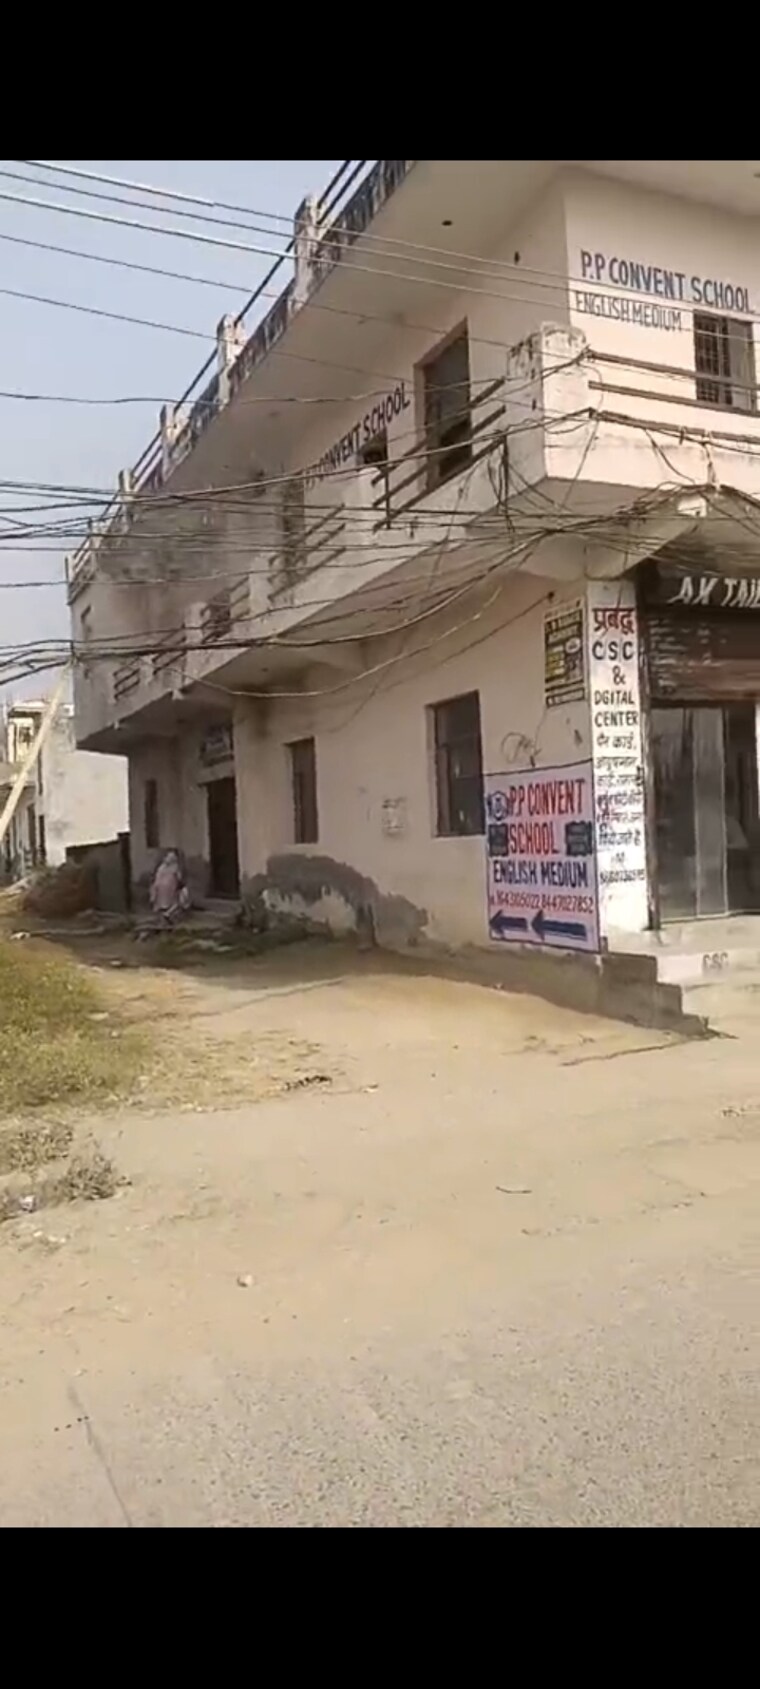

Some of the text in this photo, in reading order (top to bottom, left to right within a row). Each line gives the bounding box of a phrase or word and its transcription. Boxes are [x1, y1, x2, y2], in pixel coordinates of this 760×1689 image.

[580, 250, 756, 313] P.P CONVENT SCHOOL
[575, 290, 683, 332] ENGLISH MEDIUM
[363, 382, 411, 442] SCHOOL
[612, 665, 627, 686] &
[594, 689, 636, 706] DGITAL
[594, 711, 639, 728] CENTER
[527, 779, 585, 816] CONVENT
[509, 821, 560, 855] SCHOOL
[493, 859, 538, 885] ENGLISH
[540, 861, 588, 888] MEDIUM
